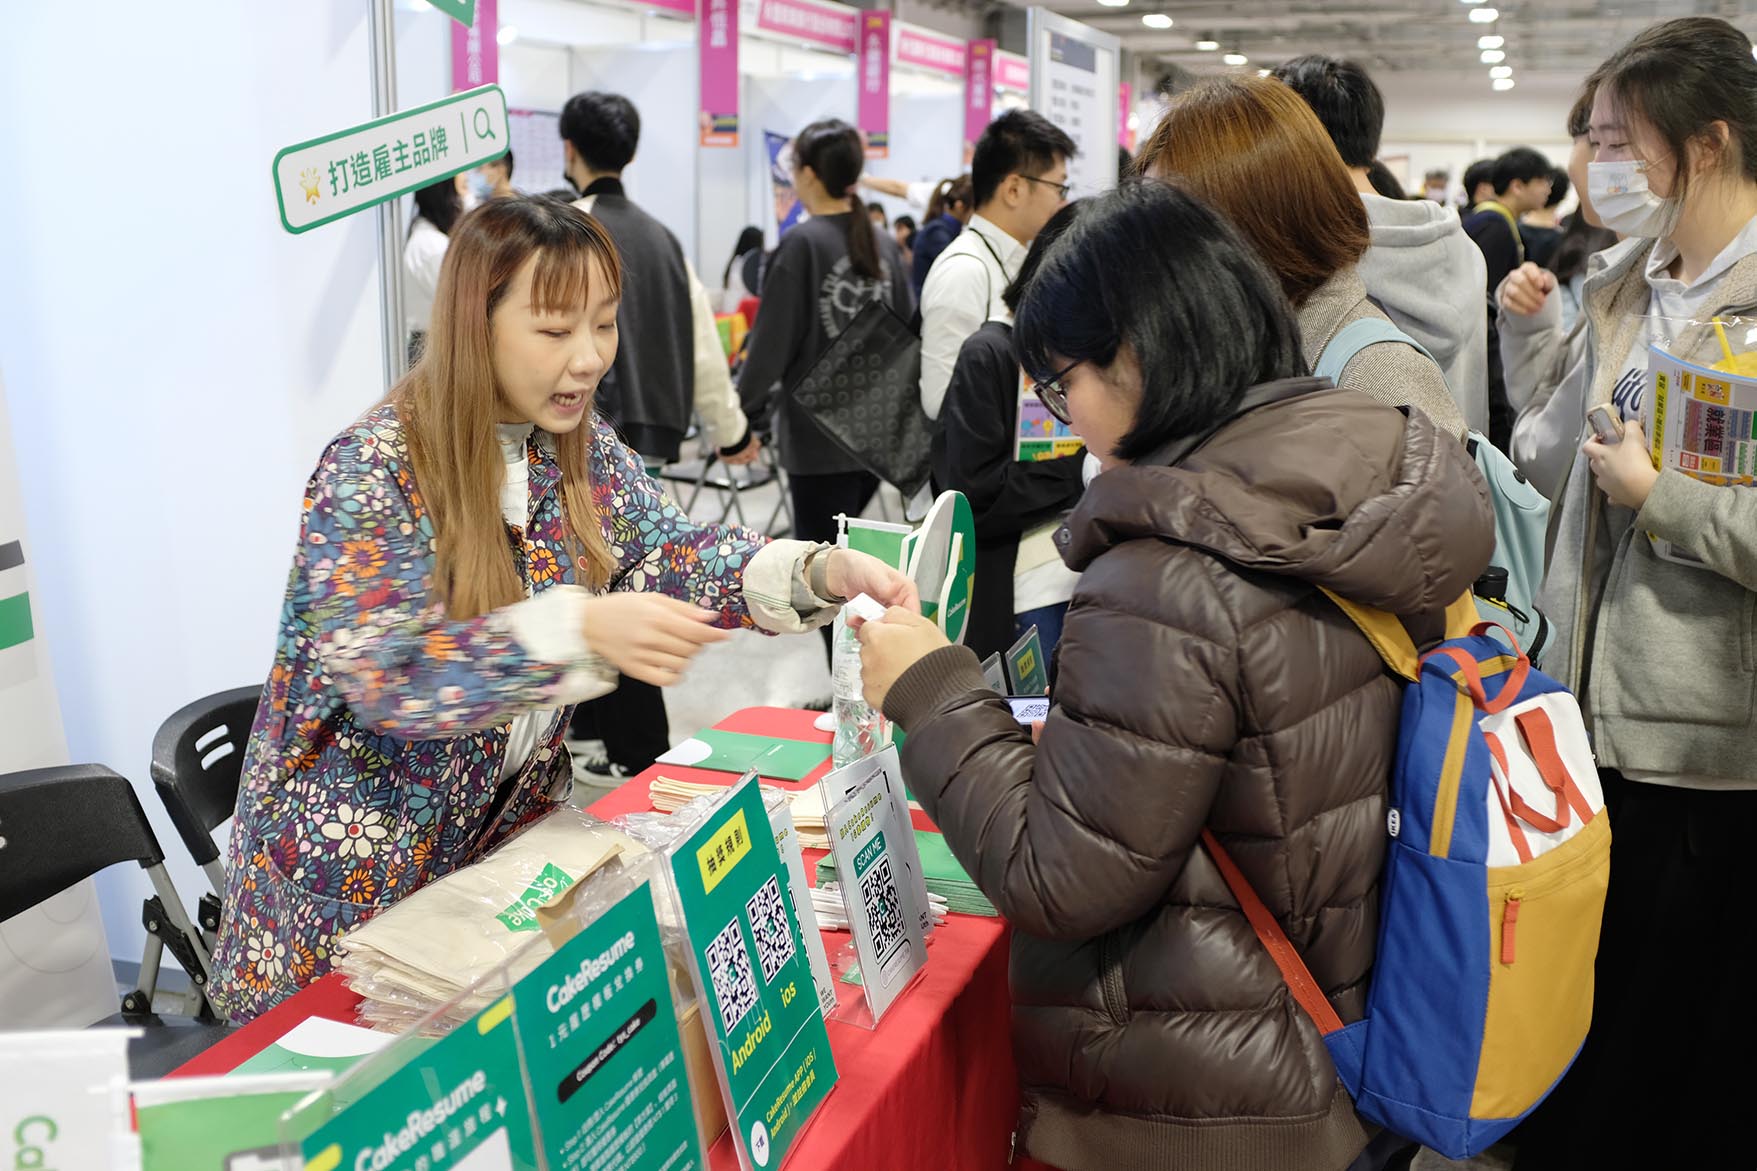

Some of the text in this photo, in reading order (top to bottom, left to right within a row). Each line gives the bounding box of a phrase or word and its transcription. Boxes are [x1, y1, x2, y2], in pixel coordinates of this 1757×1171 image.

[328, 125, 449, 197] 打造雇主品牌
[1703, 406, 1725, 455] 就業區
[856, 848, 873, 871] SCAN
[871, 836, 882, 855] ME
[546, 930, 635, 1014] CakeResume
[780, 981, 797, 1008] ios
[731, 1009, 772, 1076] Android
[576, 1055, 600, 1081] Coupon
[354, 1069, 487, 1171] CakeResume
[766, 1079, 795, 1123] CakeResume
[770, 1105, 789, 1140] Android
[14, 1114, 60, 1171] Ca
